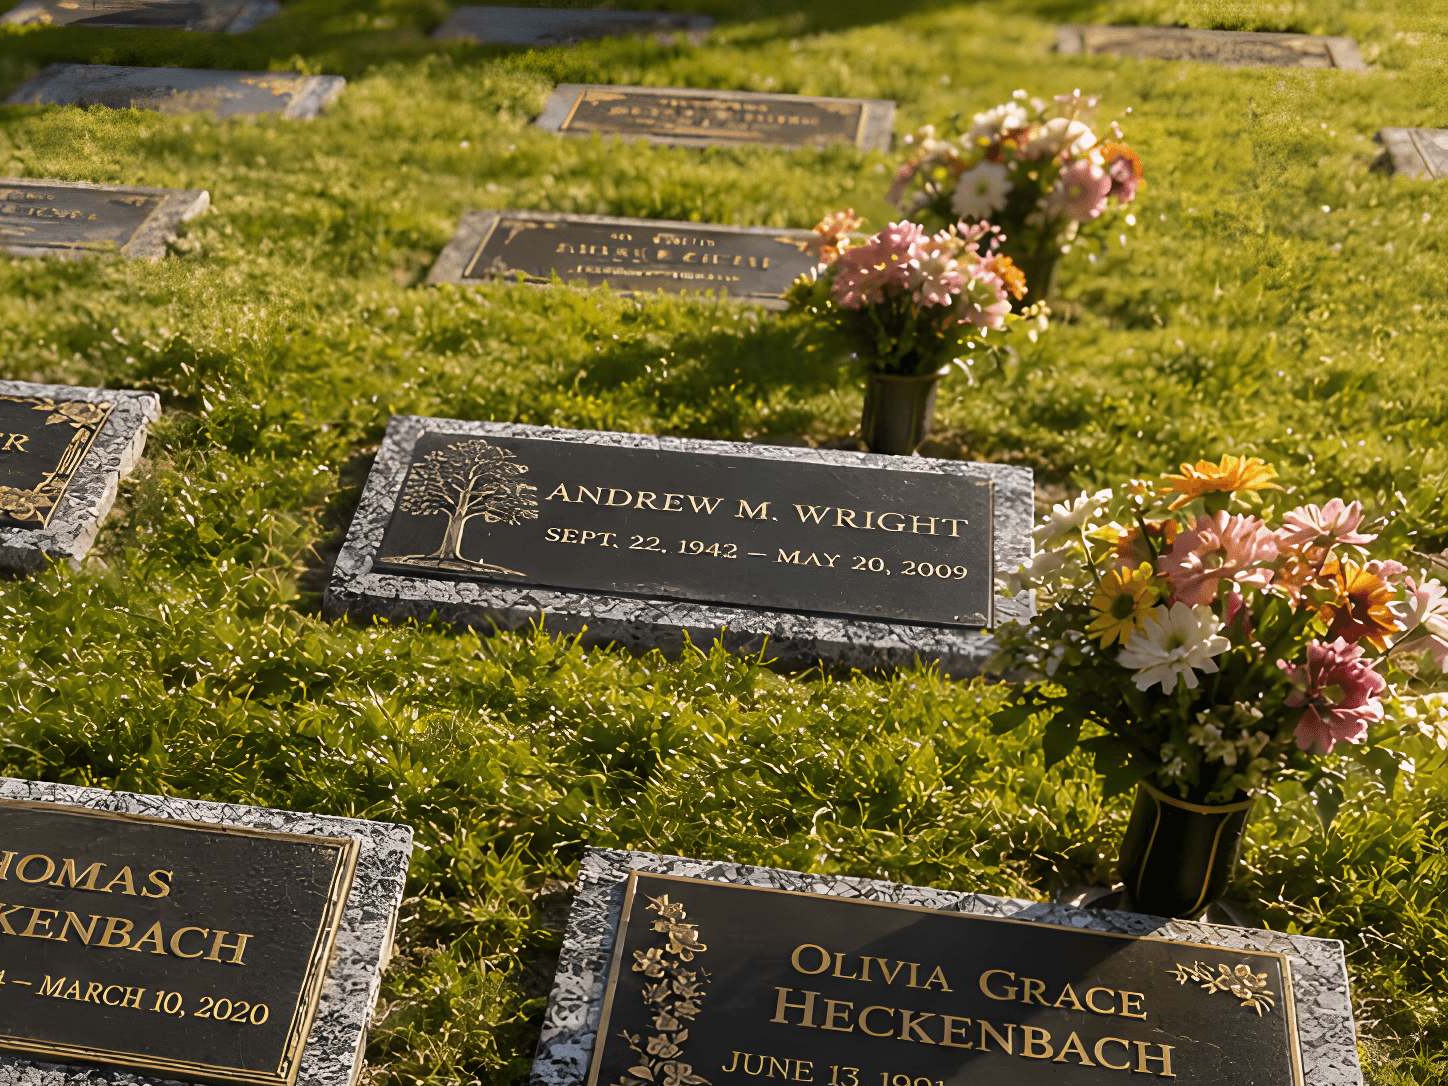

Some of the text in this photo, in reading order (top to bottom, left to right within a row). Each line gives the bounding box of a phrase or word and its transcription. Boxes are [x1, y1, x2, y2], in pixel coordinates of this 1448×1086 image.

[545, 482, 969, 538] ANDREW M. WRIGHT
[544, 527, 619, 549] SEPT.
[677, 539, 738, 559] 1942
[772, 548, 841, 569] MAY
[852, 556, 891, 576] 20,
[901, 560, 969, 581] 2009
[35, 974, 146, 1011] MARCH
[151, 990, 185, 1019] 10,
[194, 996, 269, 1026] 2020
[790, 943, 1148, 1021] OLIVIA GRACE
[769, 986, 1177, 1078] HECKENBACH
[722, 1050, 815, 1083] JUNE
